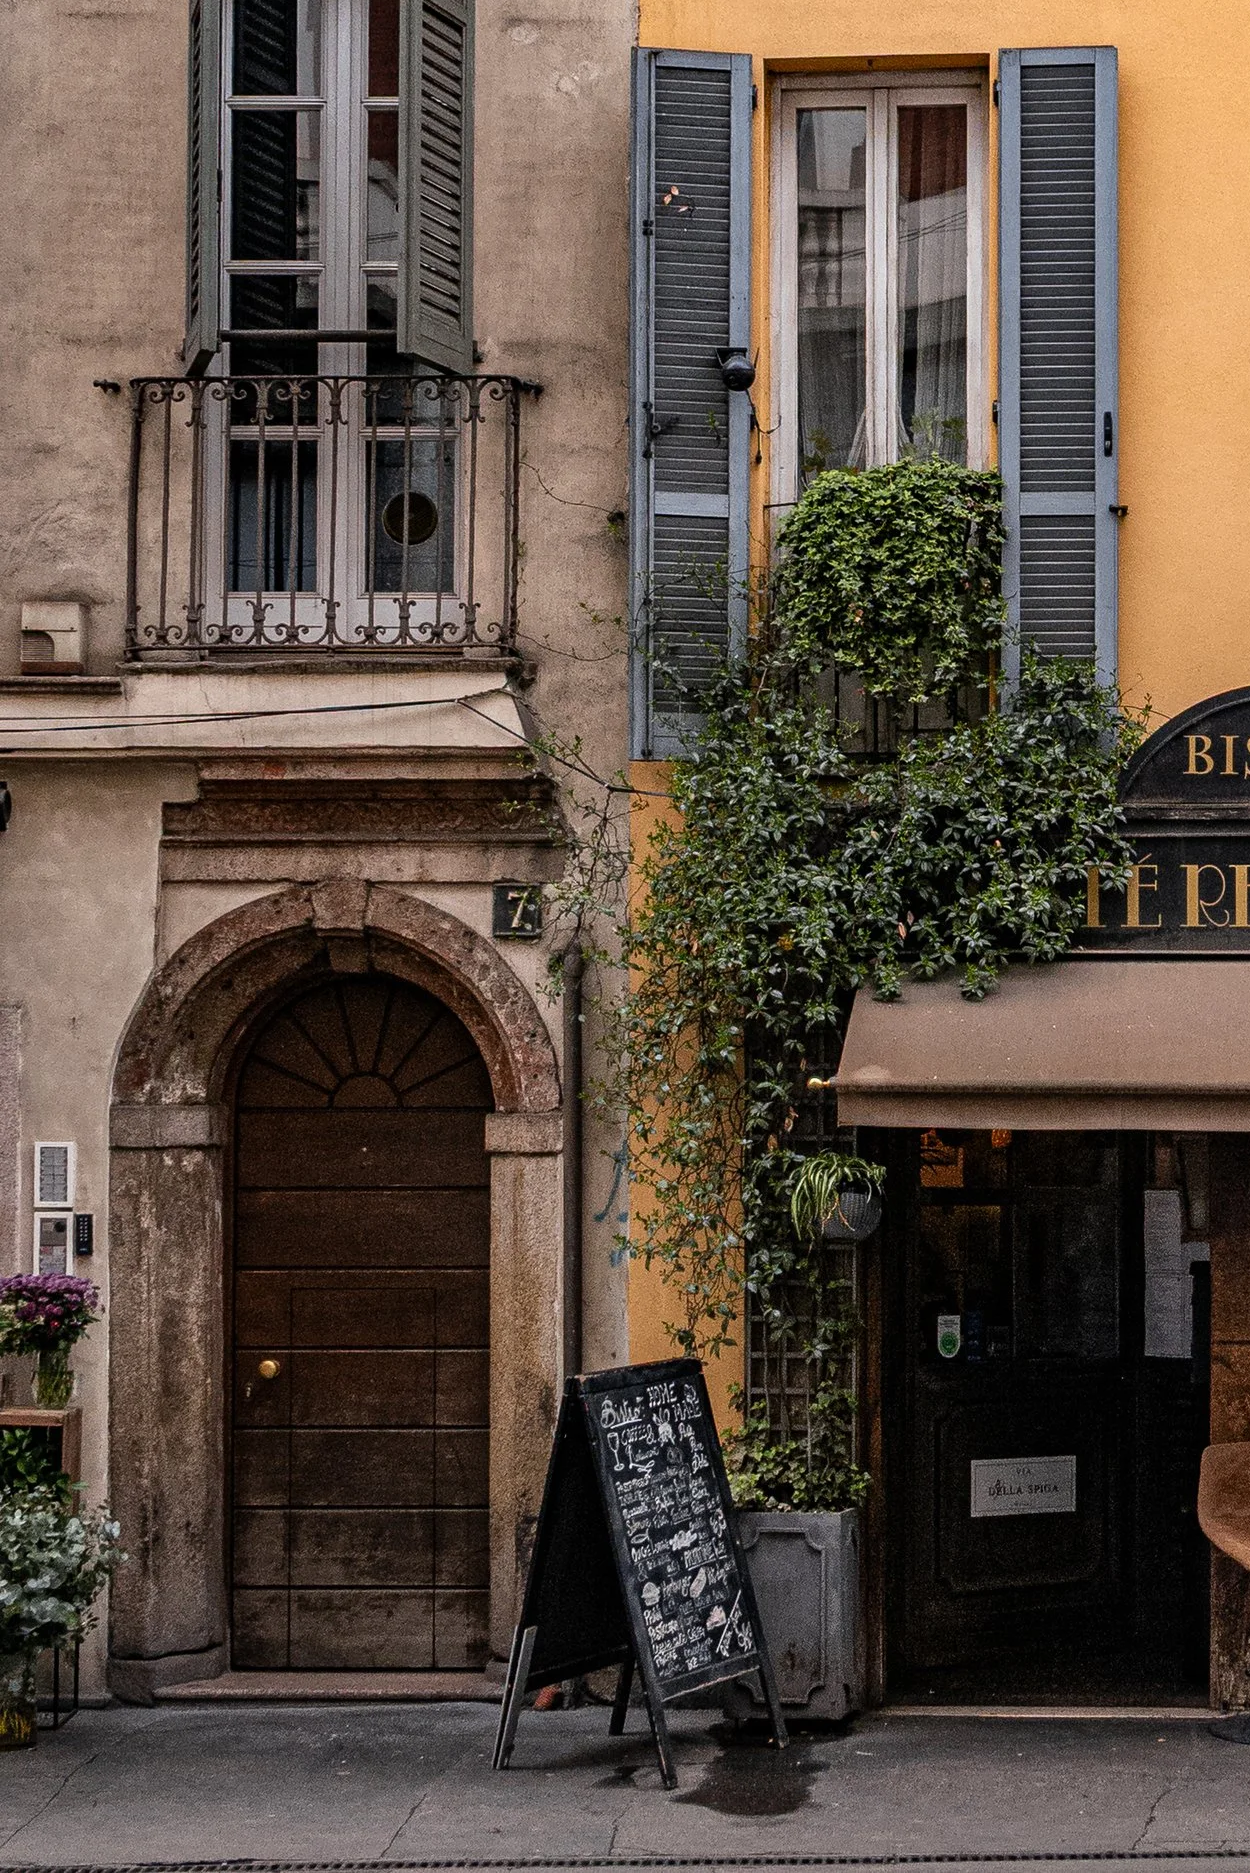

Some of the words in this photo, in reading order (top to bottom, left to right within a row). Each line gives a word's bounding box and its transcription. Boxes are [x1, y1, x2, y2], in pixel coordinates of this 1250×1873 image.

[507, 888, 531, 928] 7
[646, 1382, 677, 1408] HOME
[988, 1484, 1023, 1497] DELLA
[1028, 1484, 1060, 1495] SPIGA
